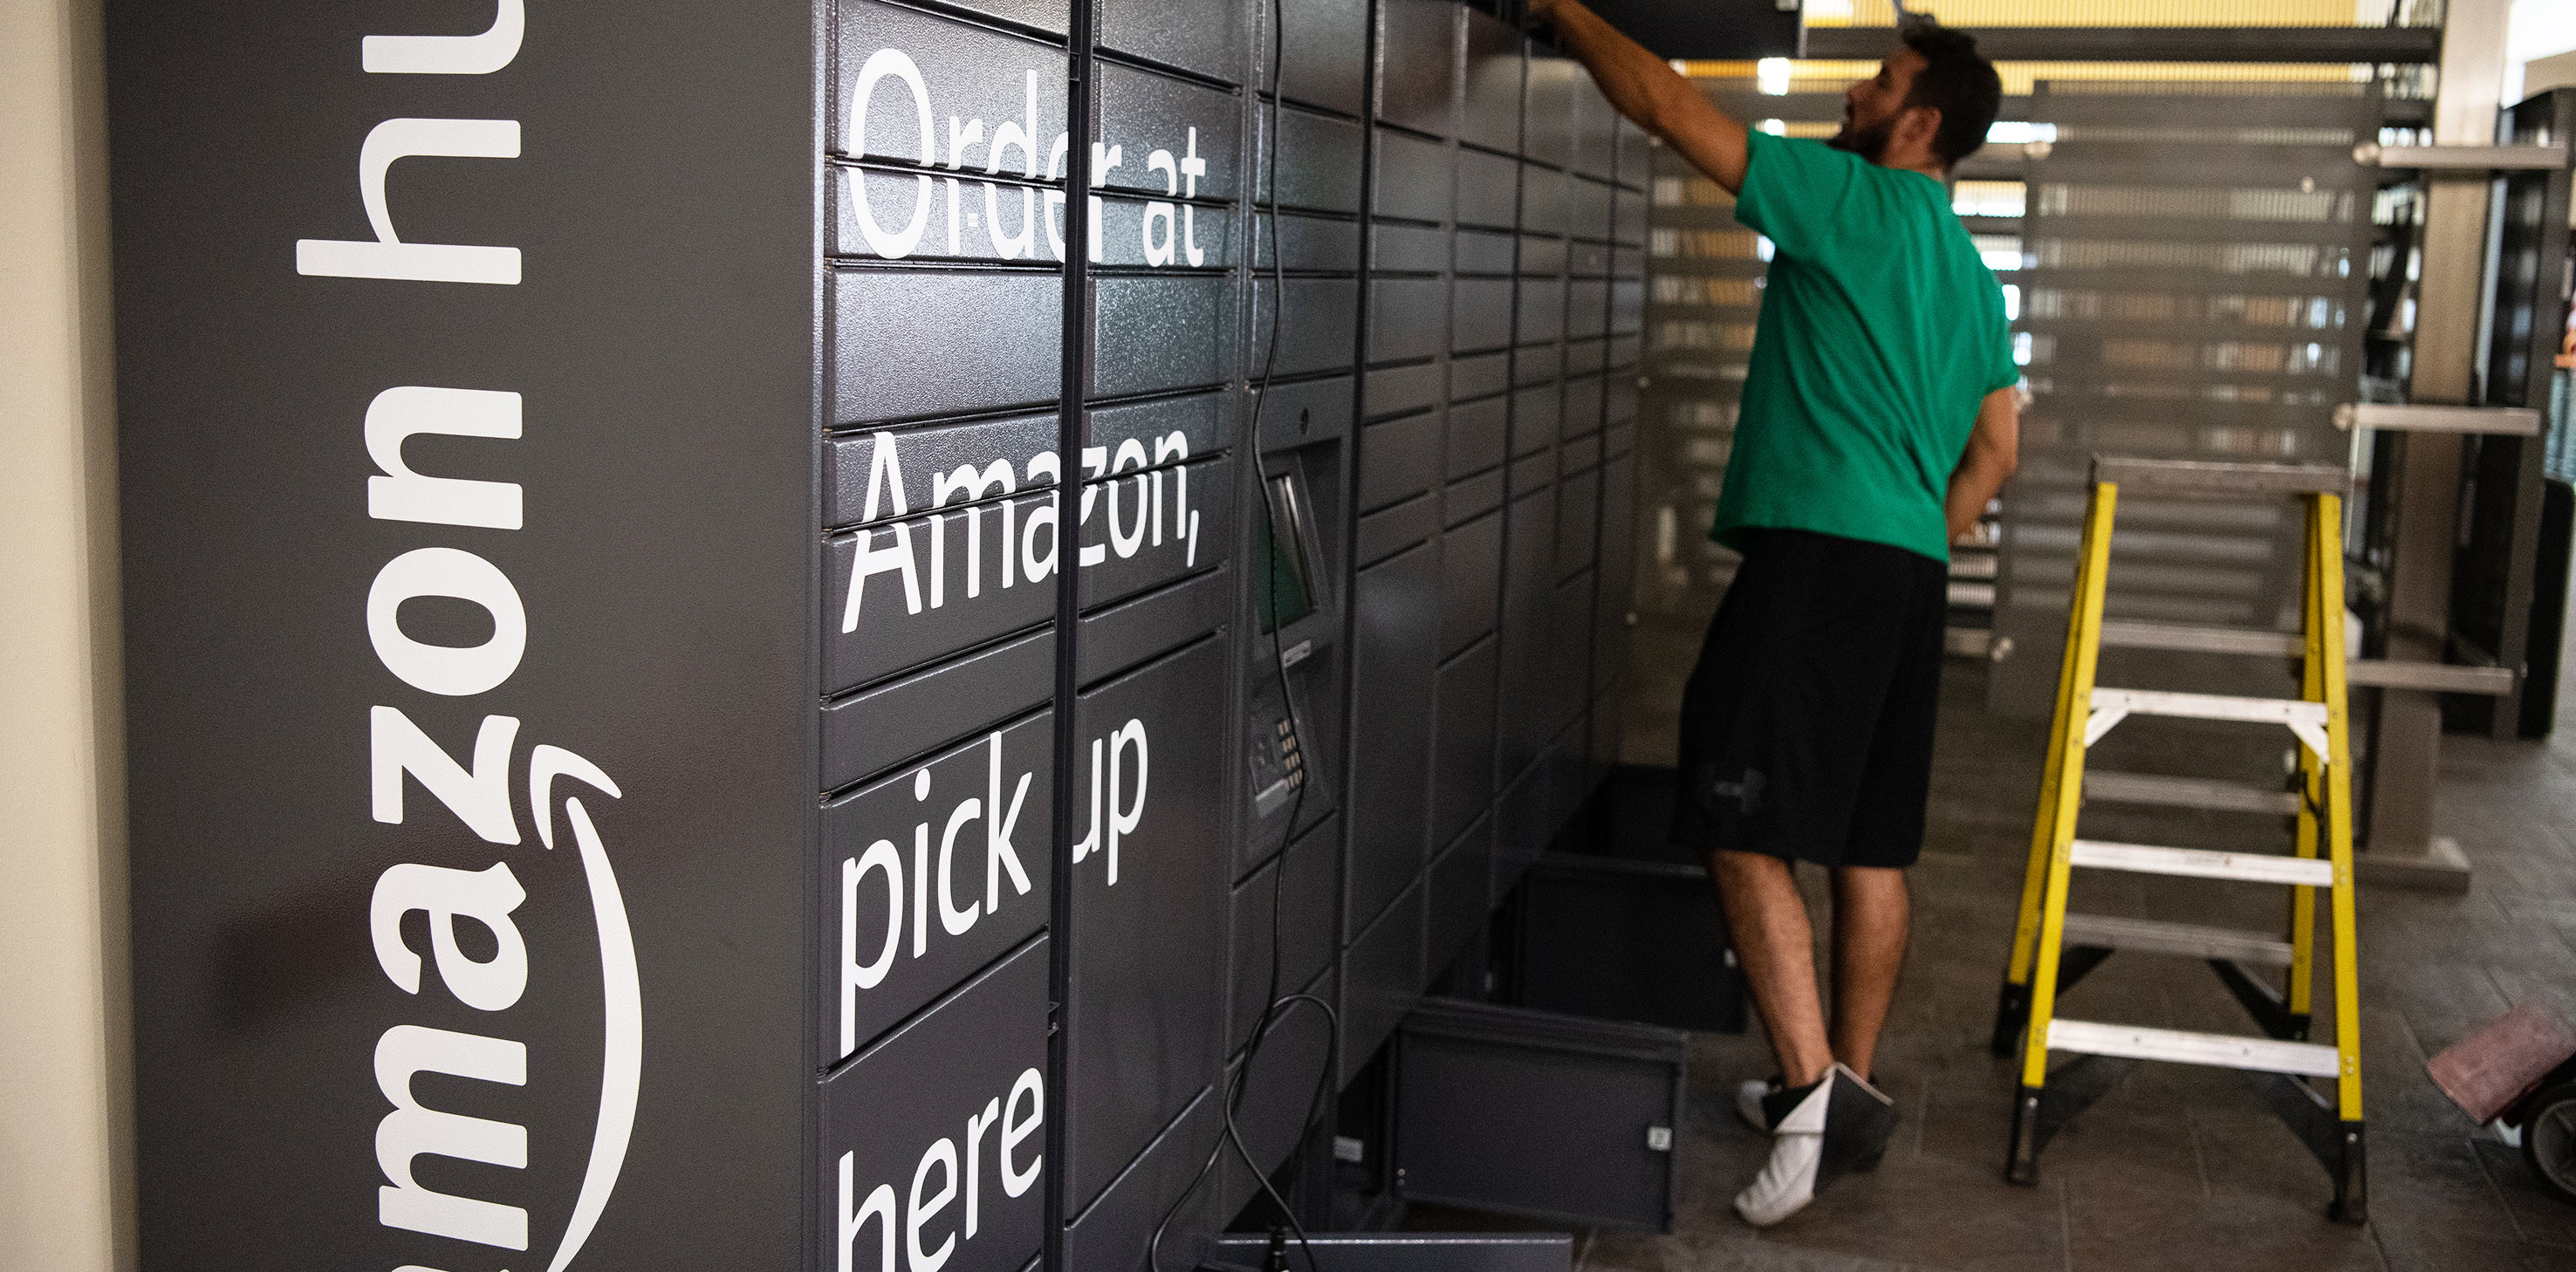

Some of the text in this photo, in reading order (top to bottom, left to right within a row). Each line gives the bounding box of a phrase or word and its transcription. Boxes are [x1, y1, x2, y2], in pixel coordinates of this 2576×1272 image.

[846, 48, 1206, 267] Order at
[842, 431, 1199, 634] Amazon,
[365, 386, 528, 1272] mazon
[840, 718, 1148, 1059] pick up
[839, 1067, 1044, 1272] here
